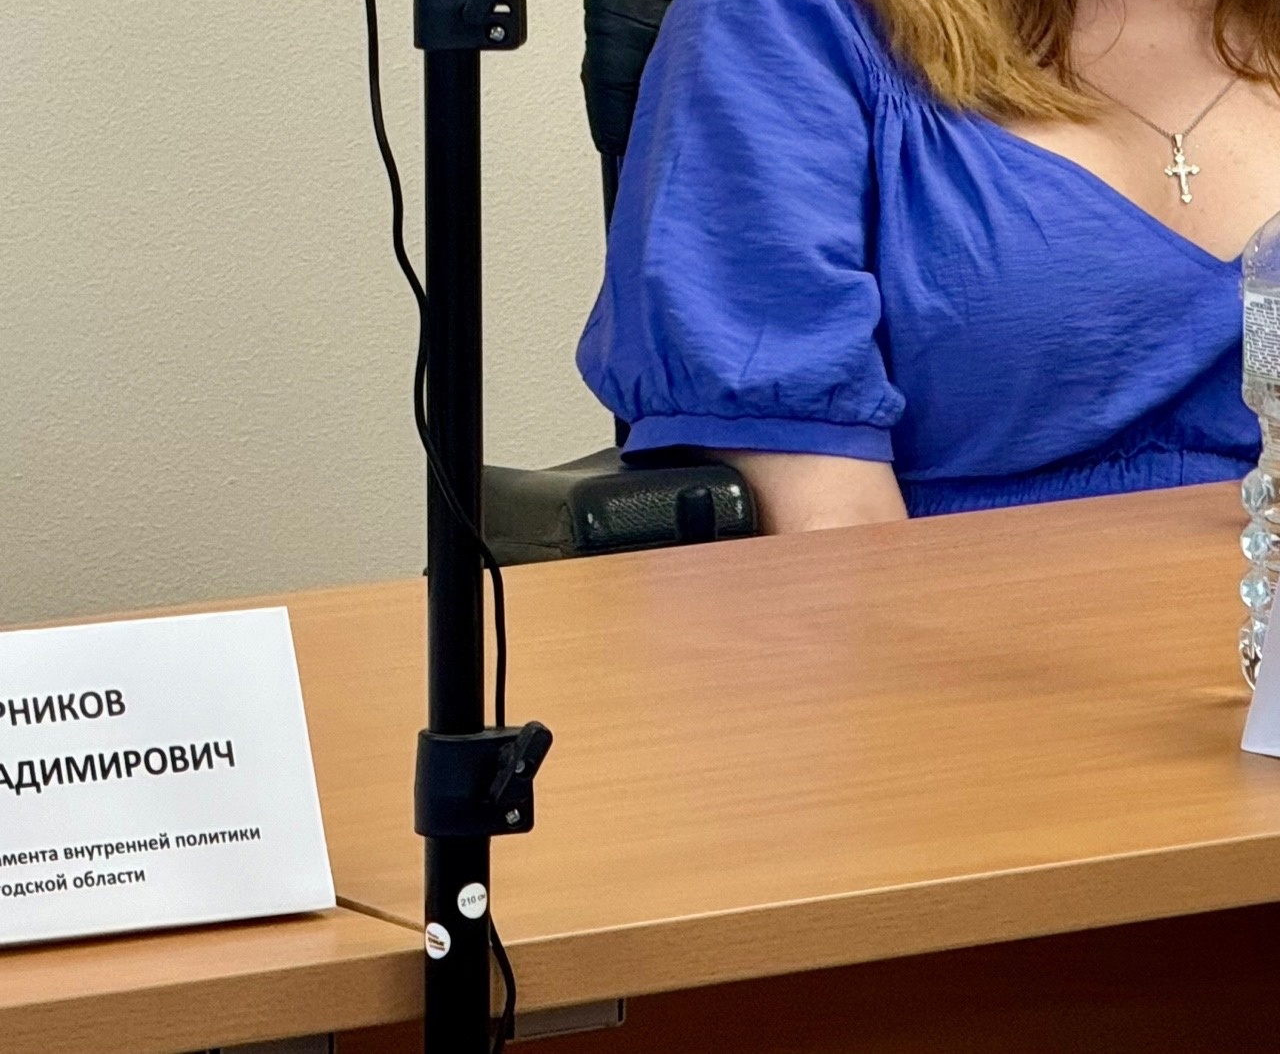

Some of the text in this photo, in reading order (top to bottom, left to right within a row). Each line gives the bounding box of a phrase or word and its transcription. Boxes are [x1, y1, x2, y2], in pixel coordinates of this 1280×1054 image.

[0, 827, 261, 867] мента внутренней политики
[0, 869, 146, 897] одской области
[460, 895, 477, 907] 210
